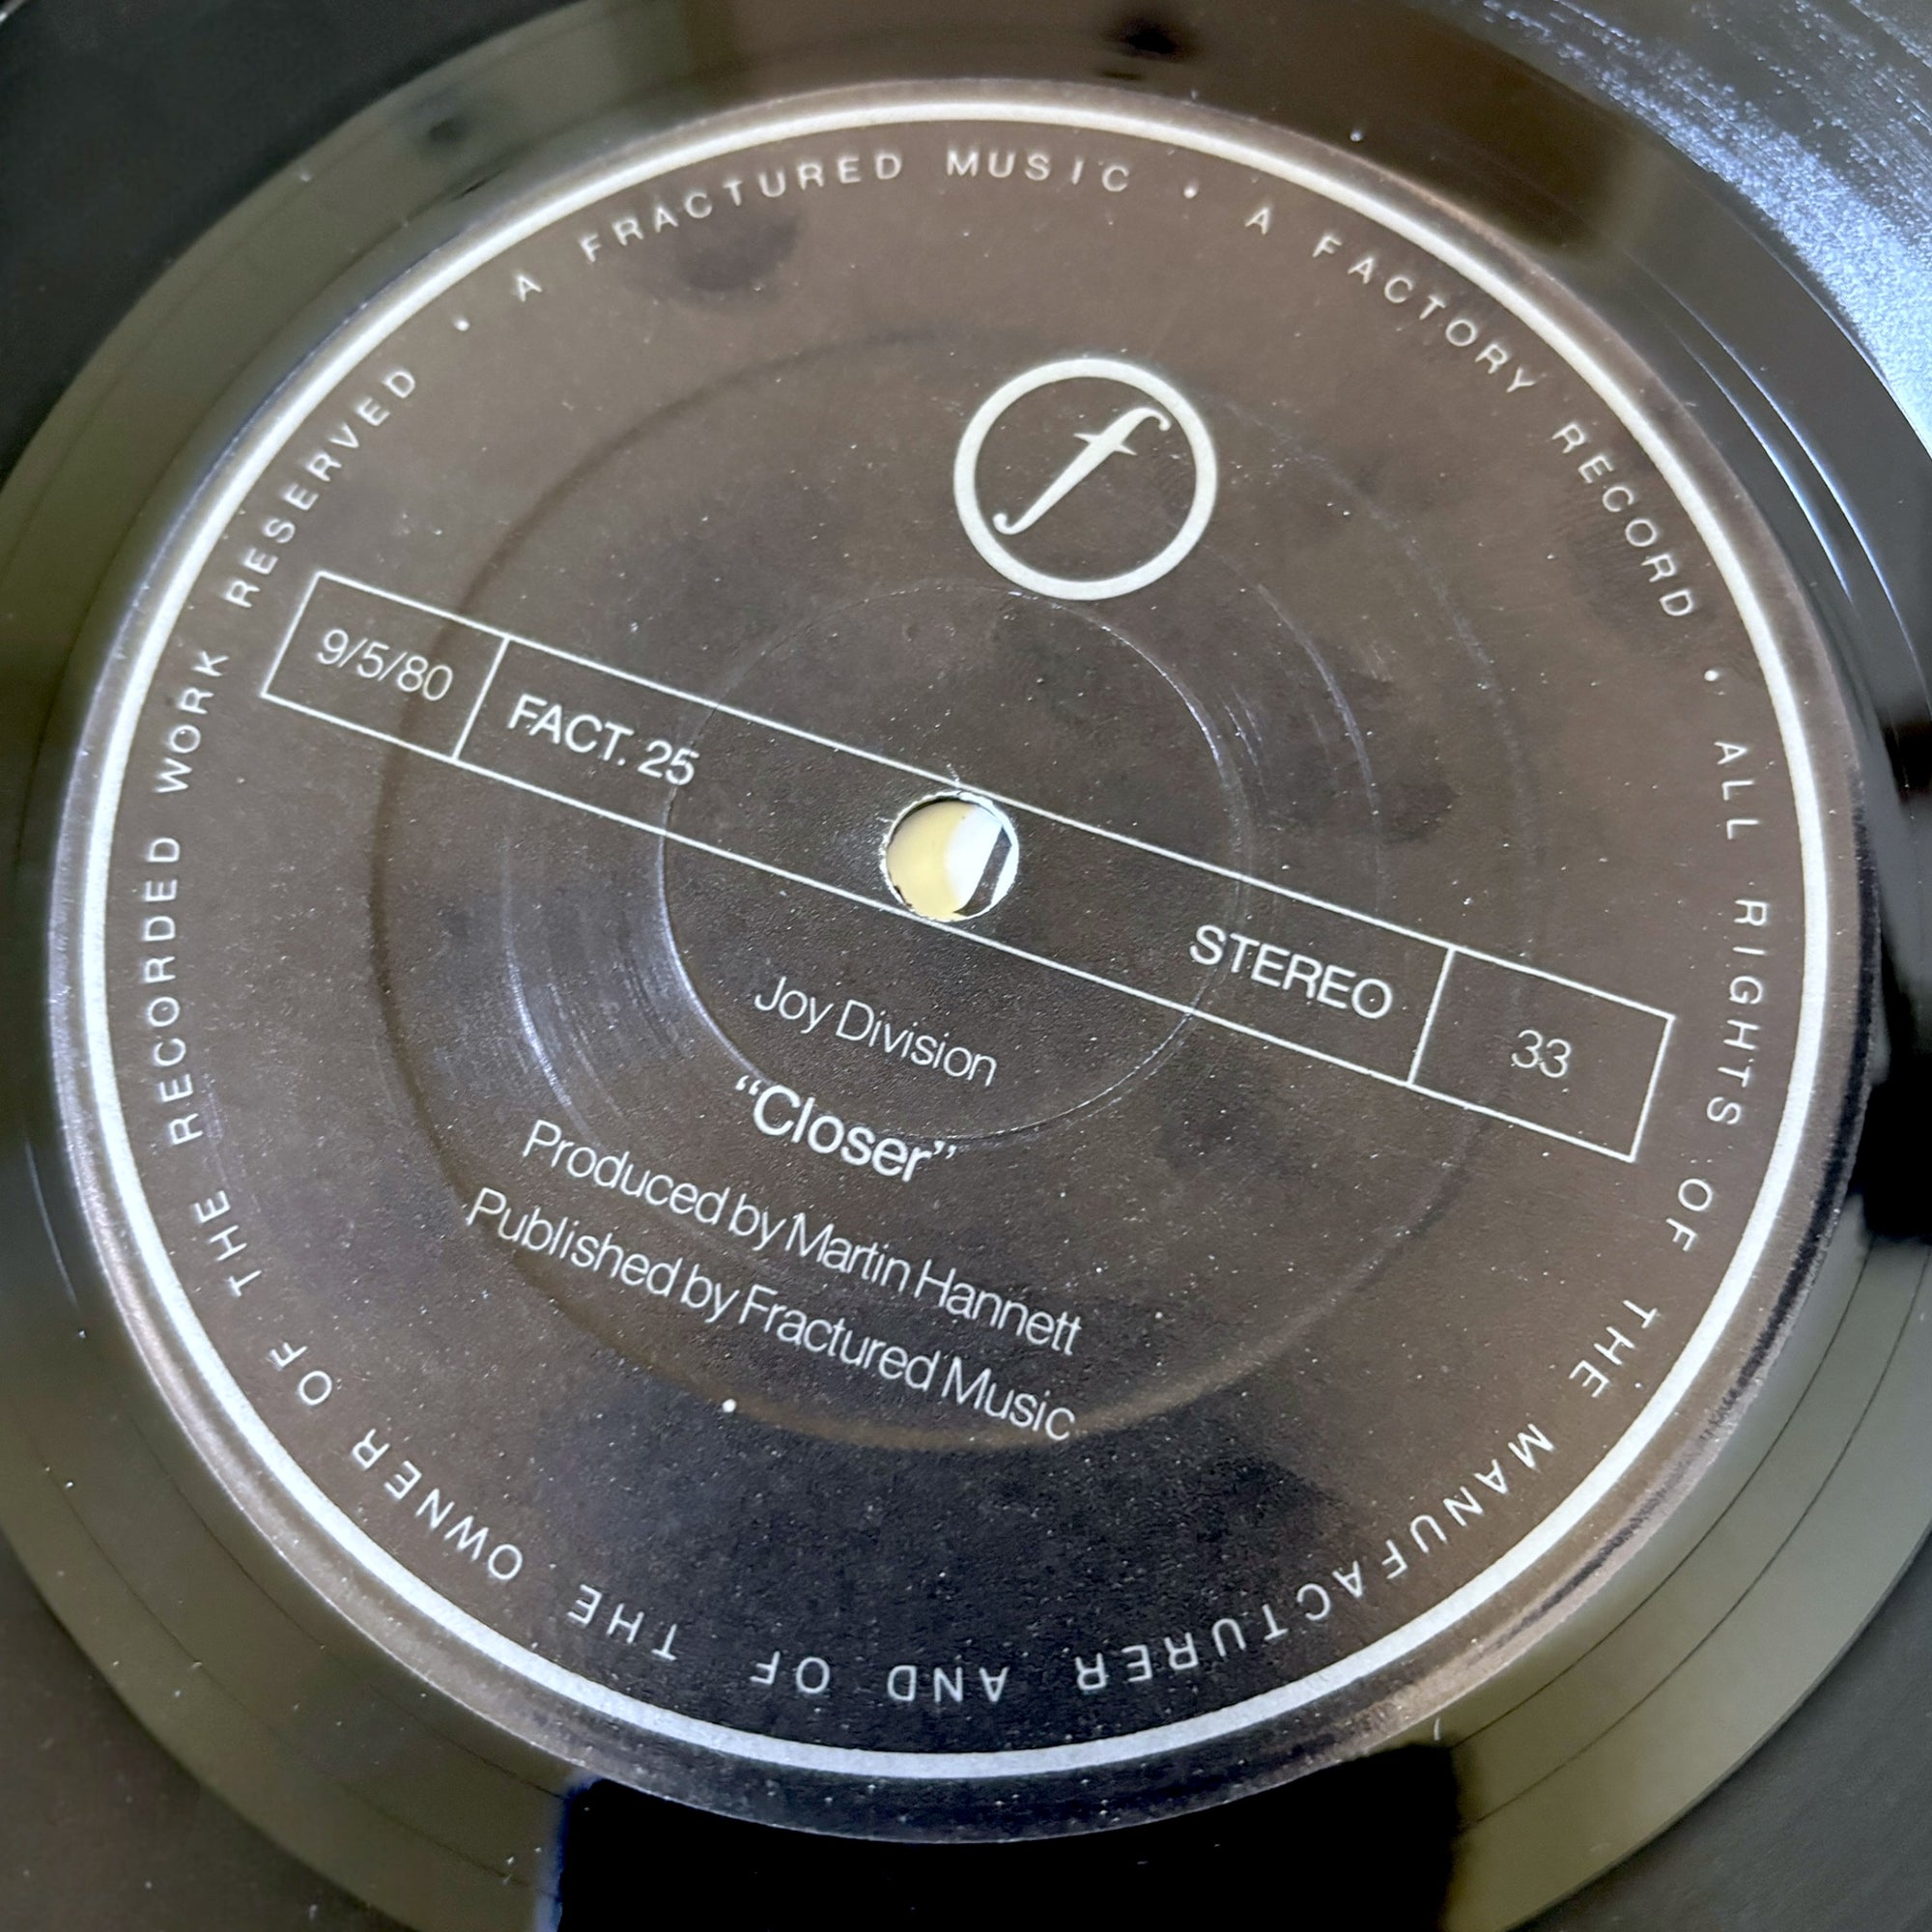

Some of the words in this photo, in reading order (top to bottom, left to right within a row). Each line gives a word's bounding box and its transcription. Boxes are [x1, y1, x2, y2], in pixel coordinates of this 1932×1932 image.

[514, 273, 542, 302] A
[579, 152, 903, 263] FRACTURED
[947, 148, 1130, 193] MUSIC
[1245, 207, 1271, 235] A
[1313, 235, 1536, 393] FACTORY
[1552, 422, 1695, 616] RECORD
[224, 368, 416, 609] RESERVED
[316, 628, 453, 701] 9/5/80
[156, 651, 229, 793] WORK
[508, 694, 635, 766] FACT.
[639, 739, 700, 785] 25
[1714, 741, 1760, 839] ALL
[141, 837, 204, 1146] RECORDED
[1188, 923, 1393, 1019] STEREO
[1707, 899, 1769, 1125] RIGHTS
[753, 976, 834, 1033] Joy
[836, 999, 997, 1087] Division
[1510, 1029, 1572, 1078] 33
[193, 1190, 262, 1297] THE
[522, 1119, 729, 1225] Produced
[728, 1192, 786, 1251] by
[787, 1211, 911, 1294] Martin
[914, 1260, 1082, 1355] Hannett
[1665, 1179, 1714, 1252] OF
[466, 1186, 682, 1300] Published
[680, 1263, 740, 1323] by
[740, 1283, 941, 1392] Fractured
[939, 1355, 1076, 1441] Music
[1570, 1300, 1659, 1398] THE
[270, 1342, 332, 1406] OF
[351, 1429, 524, 1580] OWNER
[1075, 1423, 1554, 1691] MANUFACTURER
[567, 1584, 677, 1662] THE
[750, 1652, 831, 1694] OF
[887, 1664, 1009, 1703] AND
